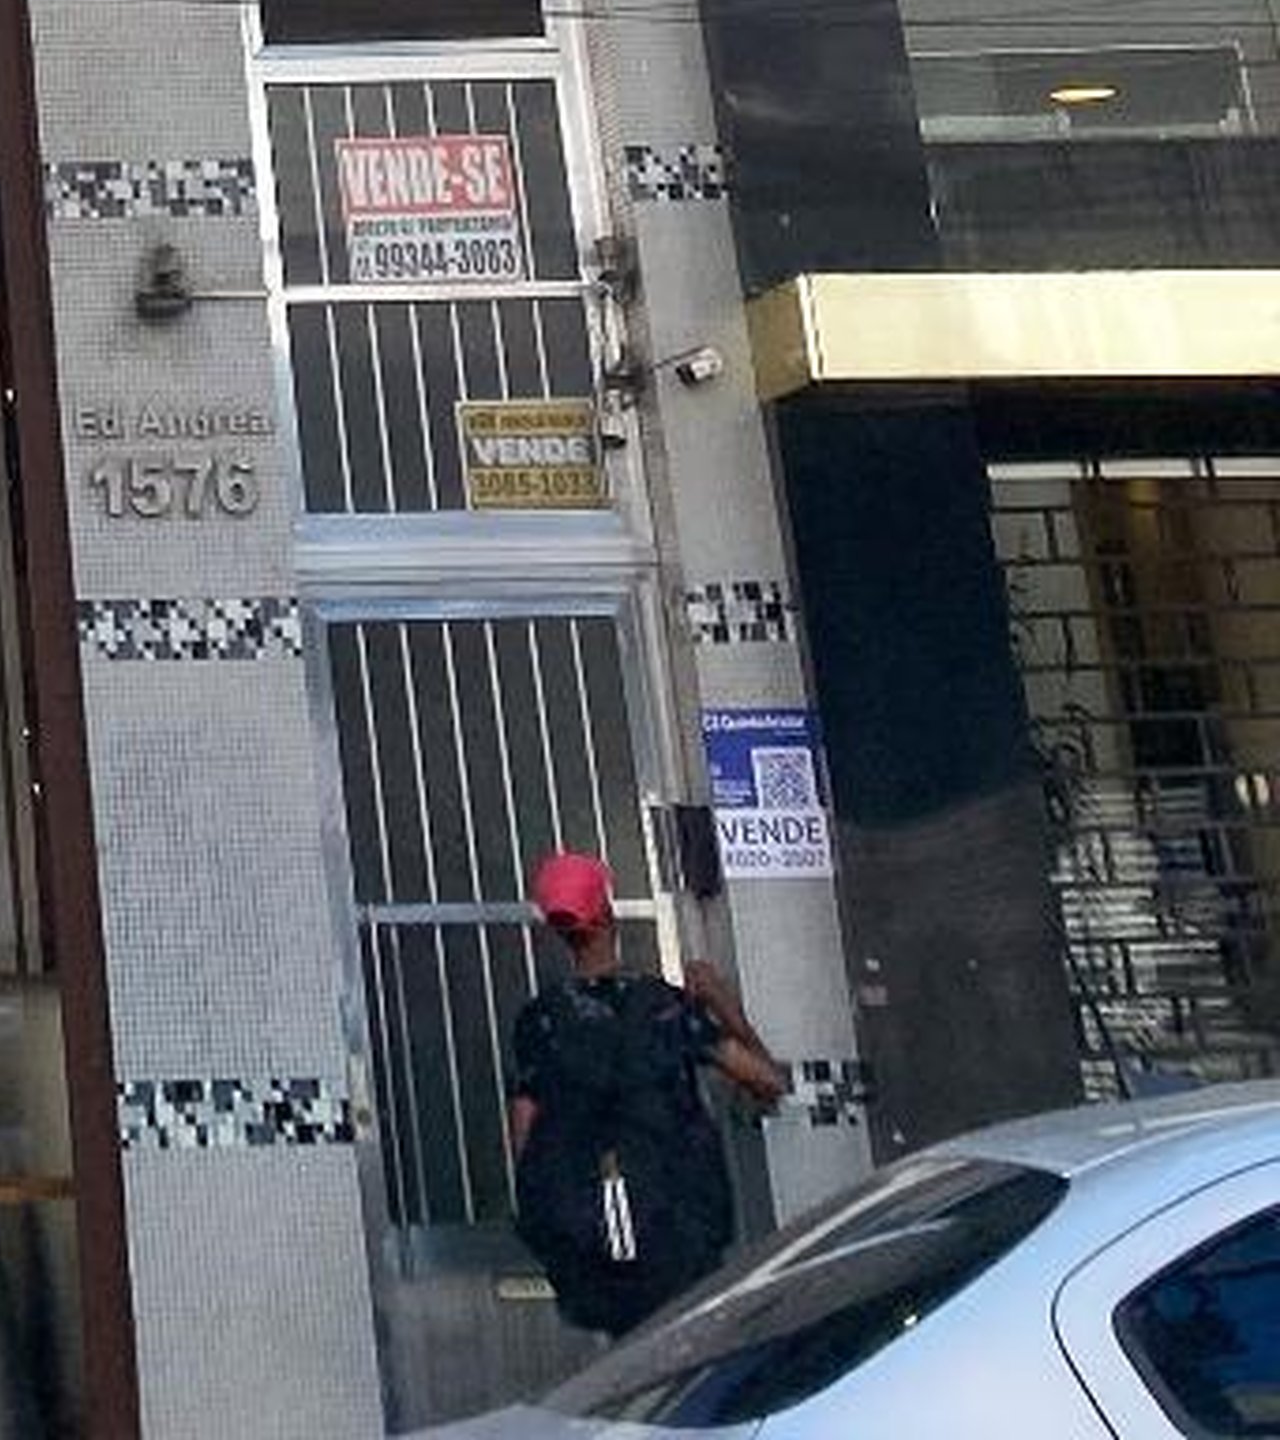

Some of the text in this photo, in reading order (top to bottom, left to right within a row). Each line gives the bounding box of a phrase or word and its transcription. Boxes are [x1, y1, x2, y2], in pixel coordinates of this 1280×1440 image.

[340, 144, 508, 207] VENDE-SE
[471, 435, 590, 468] VENDE
[93, 457, 259, 519] 1576
[720, 816, 824, 846] VENDE
